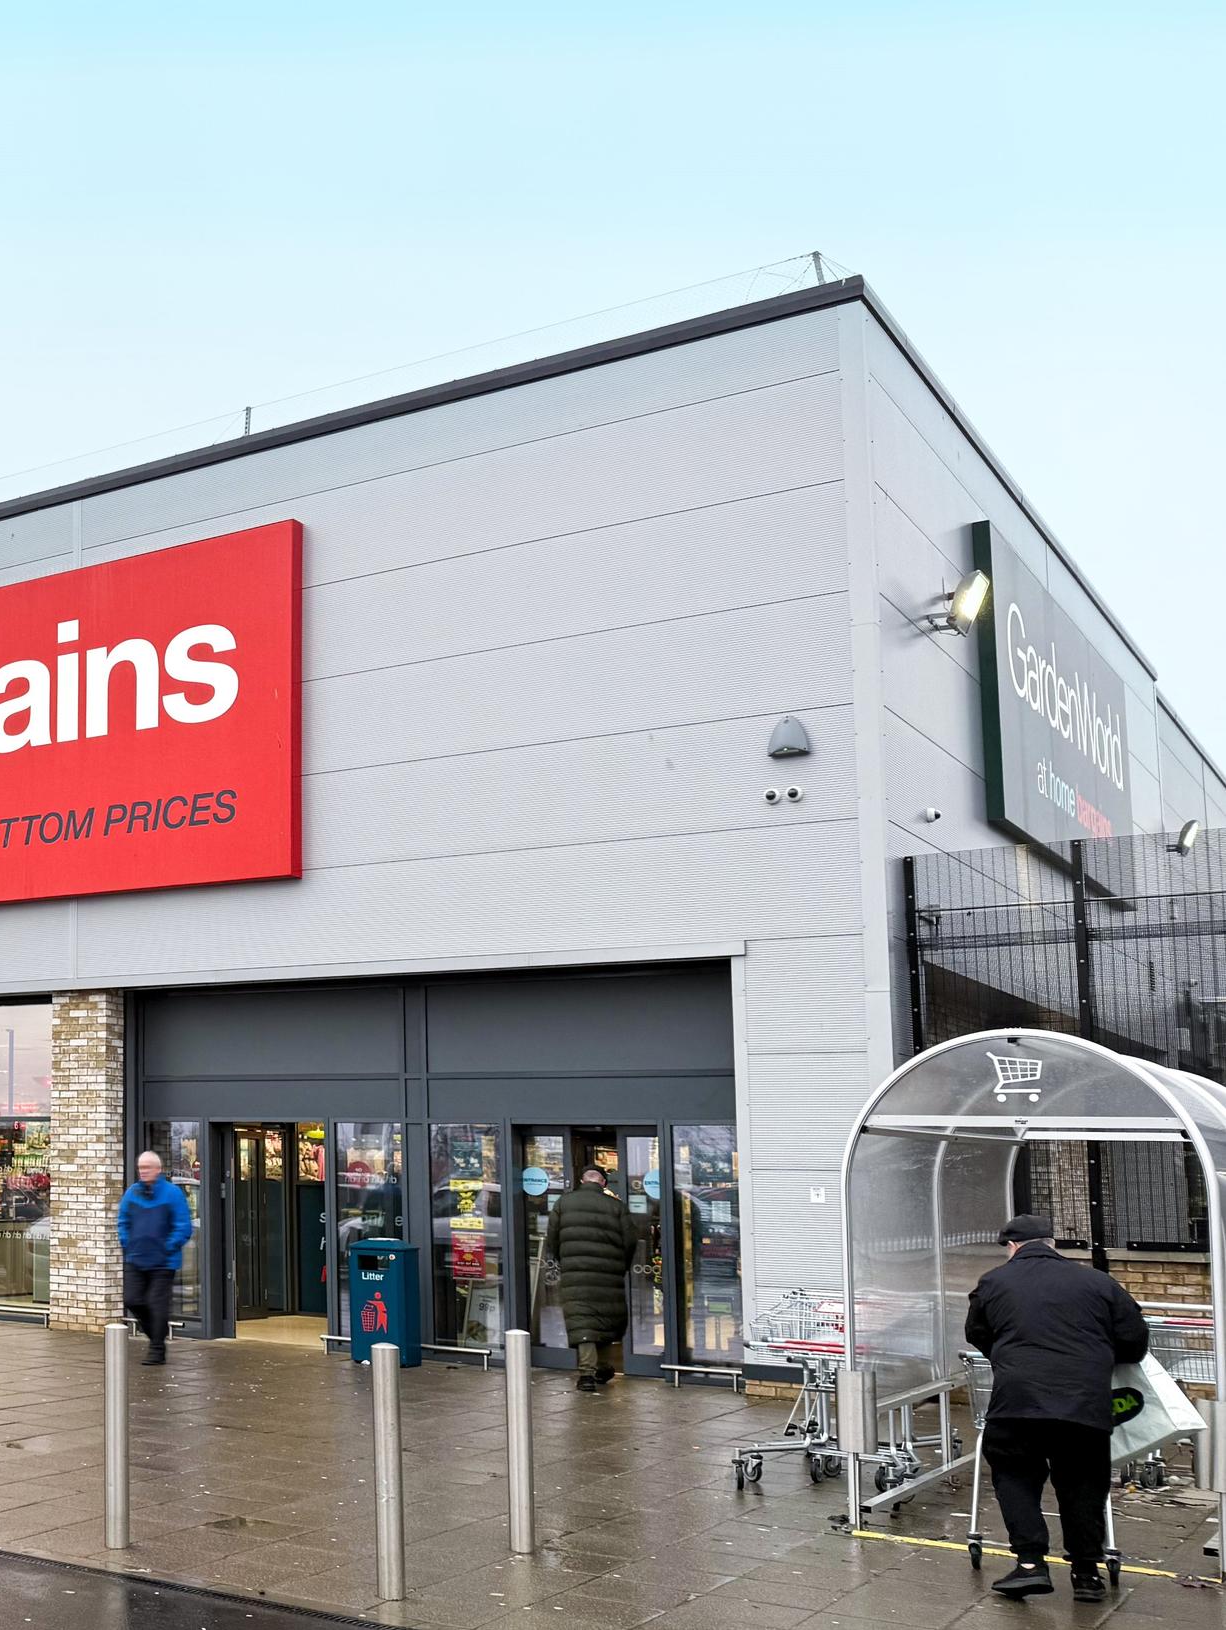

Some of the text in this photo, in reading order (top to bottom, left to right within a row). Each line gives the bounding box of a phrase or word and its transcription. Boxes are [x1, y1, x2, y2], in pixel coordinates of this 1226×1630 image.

[1007, 602, 1124, 791] GardenWorld
[103, 789, 238, 837] PRICES
[1037, 757, 1049, 798] at
[1049, 760, 1076, 818] home
[361, 1271, 385, 1281] Litter
